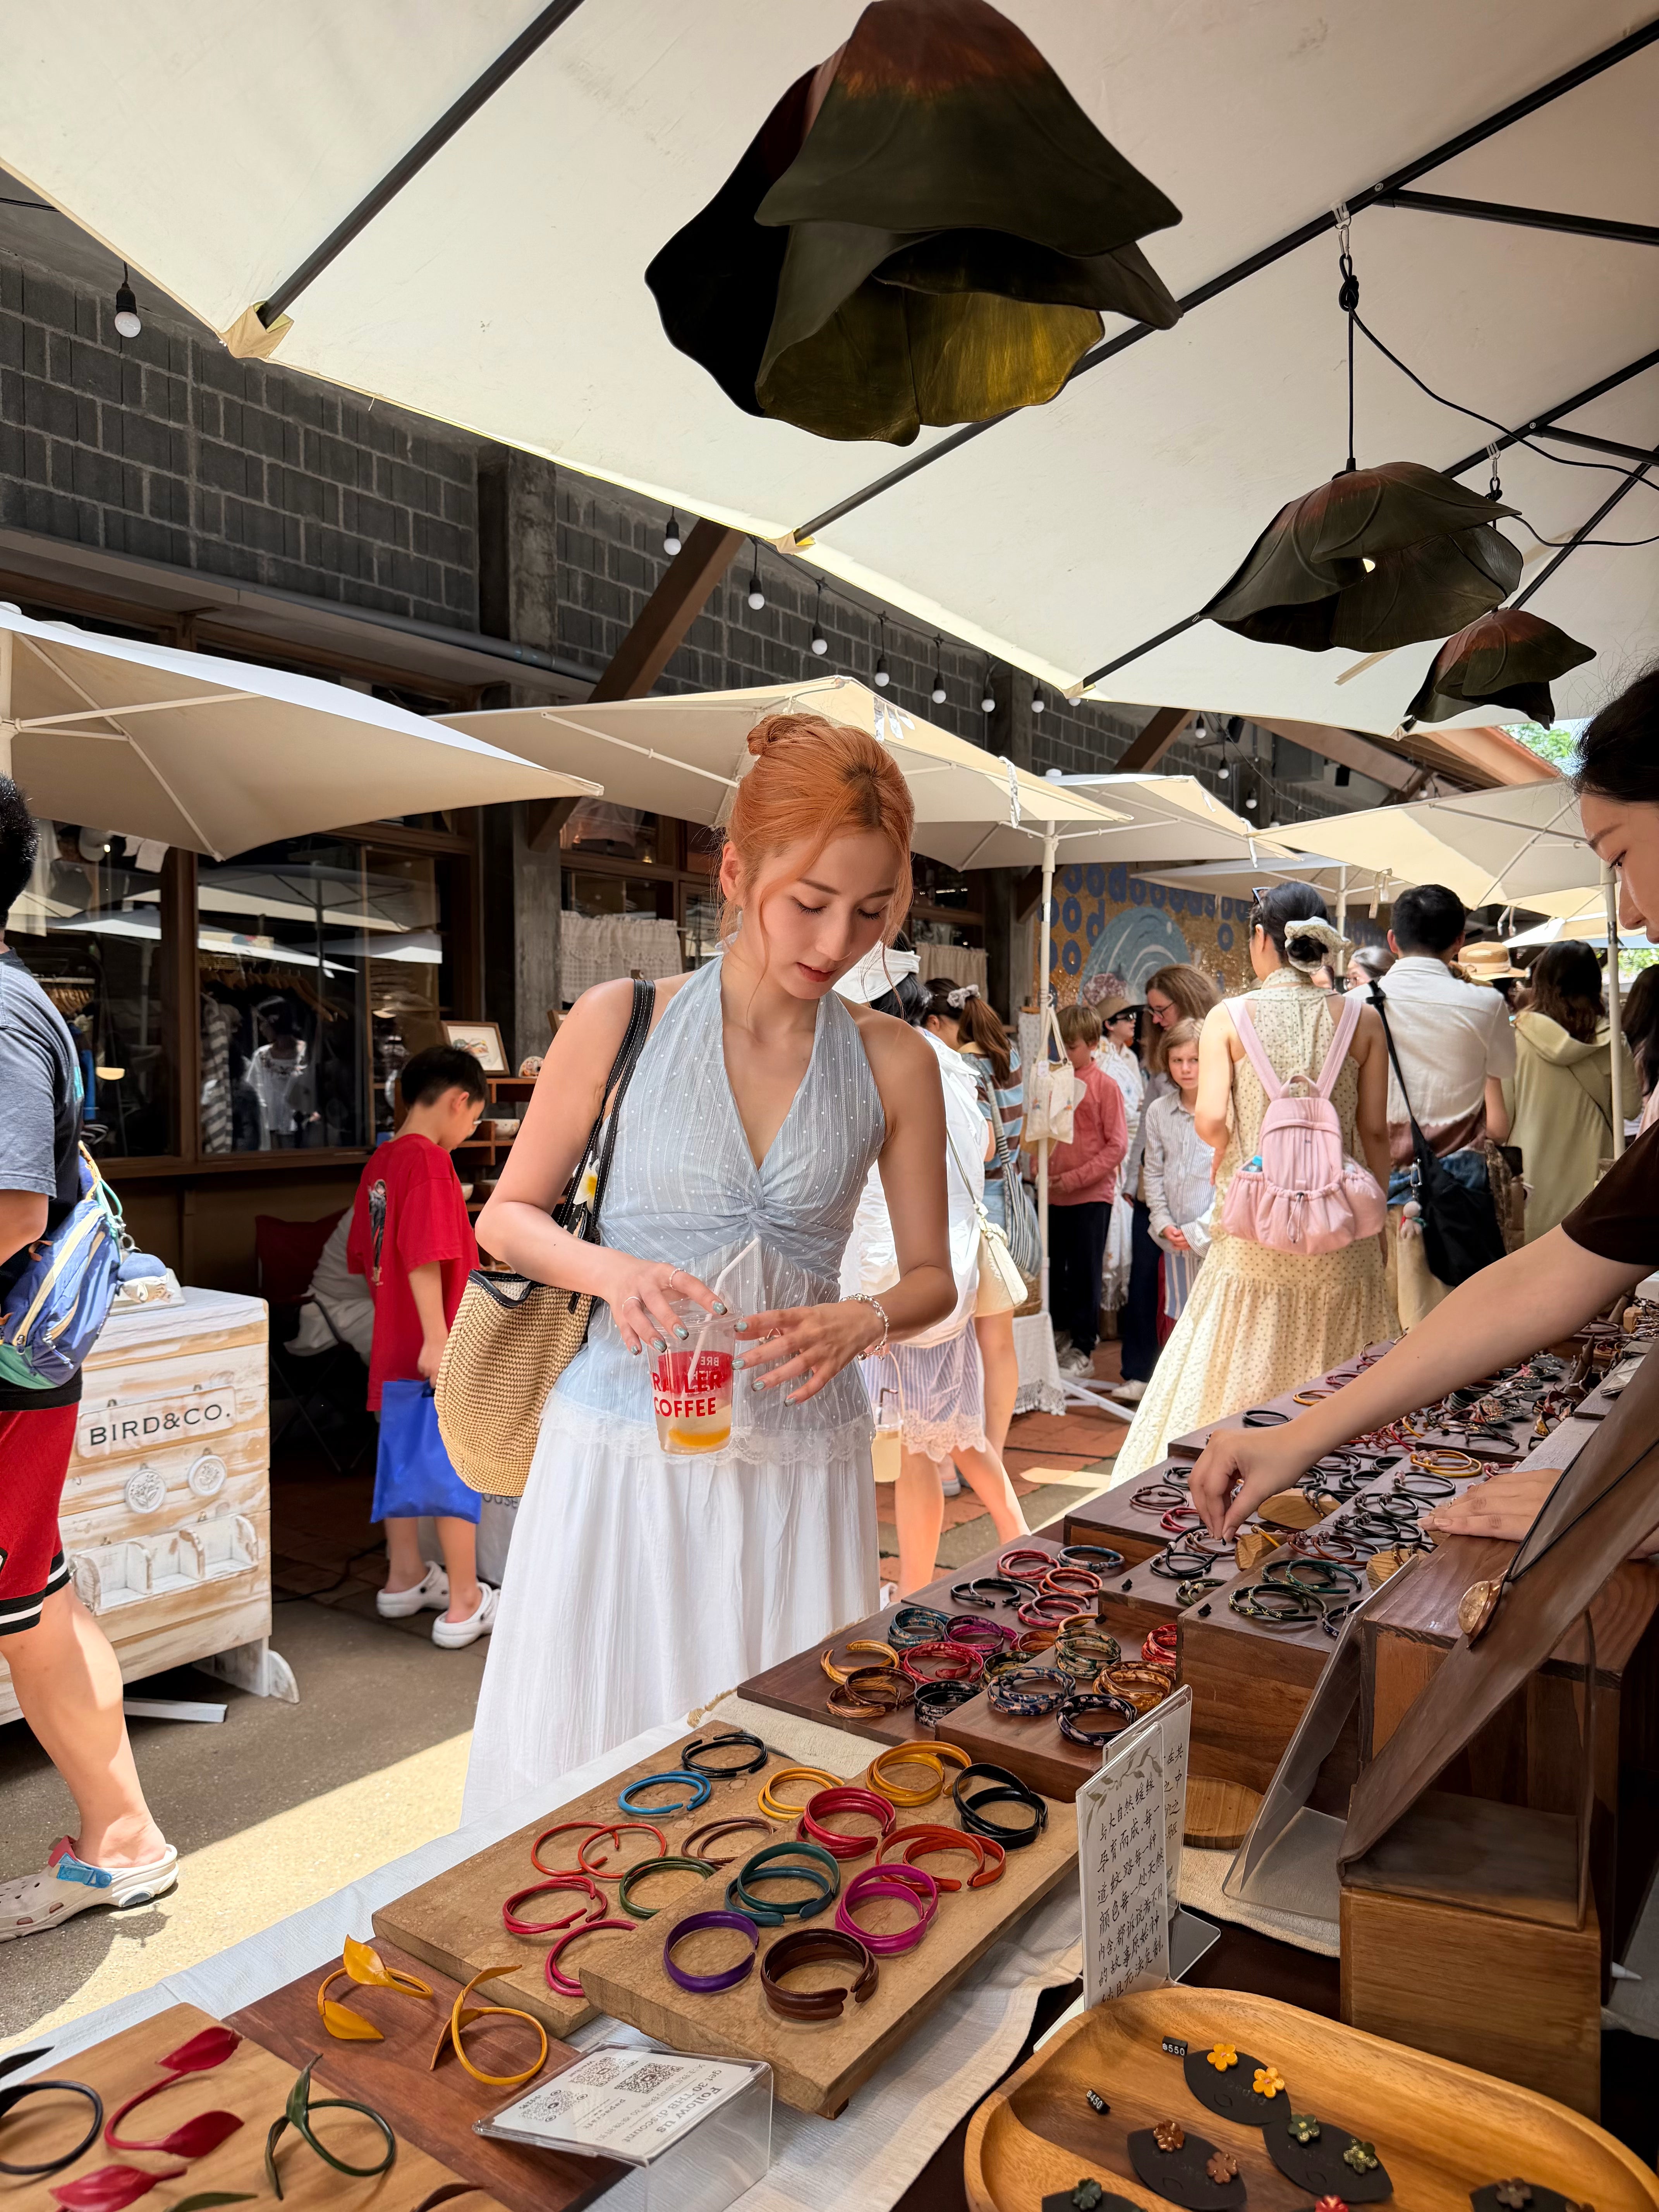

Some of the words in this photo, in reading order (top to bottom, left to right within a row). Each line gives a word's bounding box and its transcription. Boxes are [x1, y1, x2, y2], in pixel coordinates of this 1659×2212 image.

[654, 1397, 716, 1418] COFFEE
[90, 1403, 232, 1446] BIRD&CO.
[705, 2070, 722, 2081] get
[692, 2082, 708, 2091] 30
[668, 2093, 695, 2109] THB
[676, 2087, 723, 2119] Follow
[622, 2110, 668, 2142] discount
[656, 2121, 676, 2133] us
